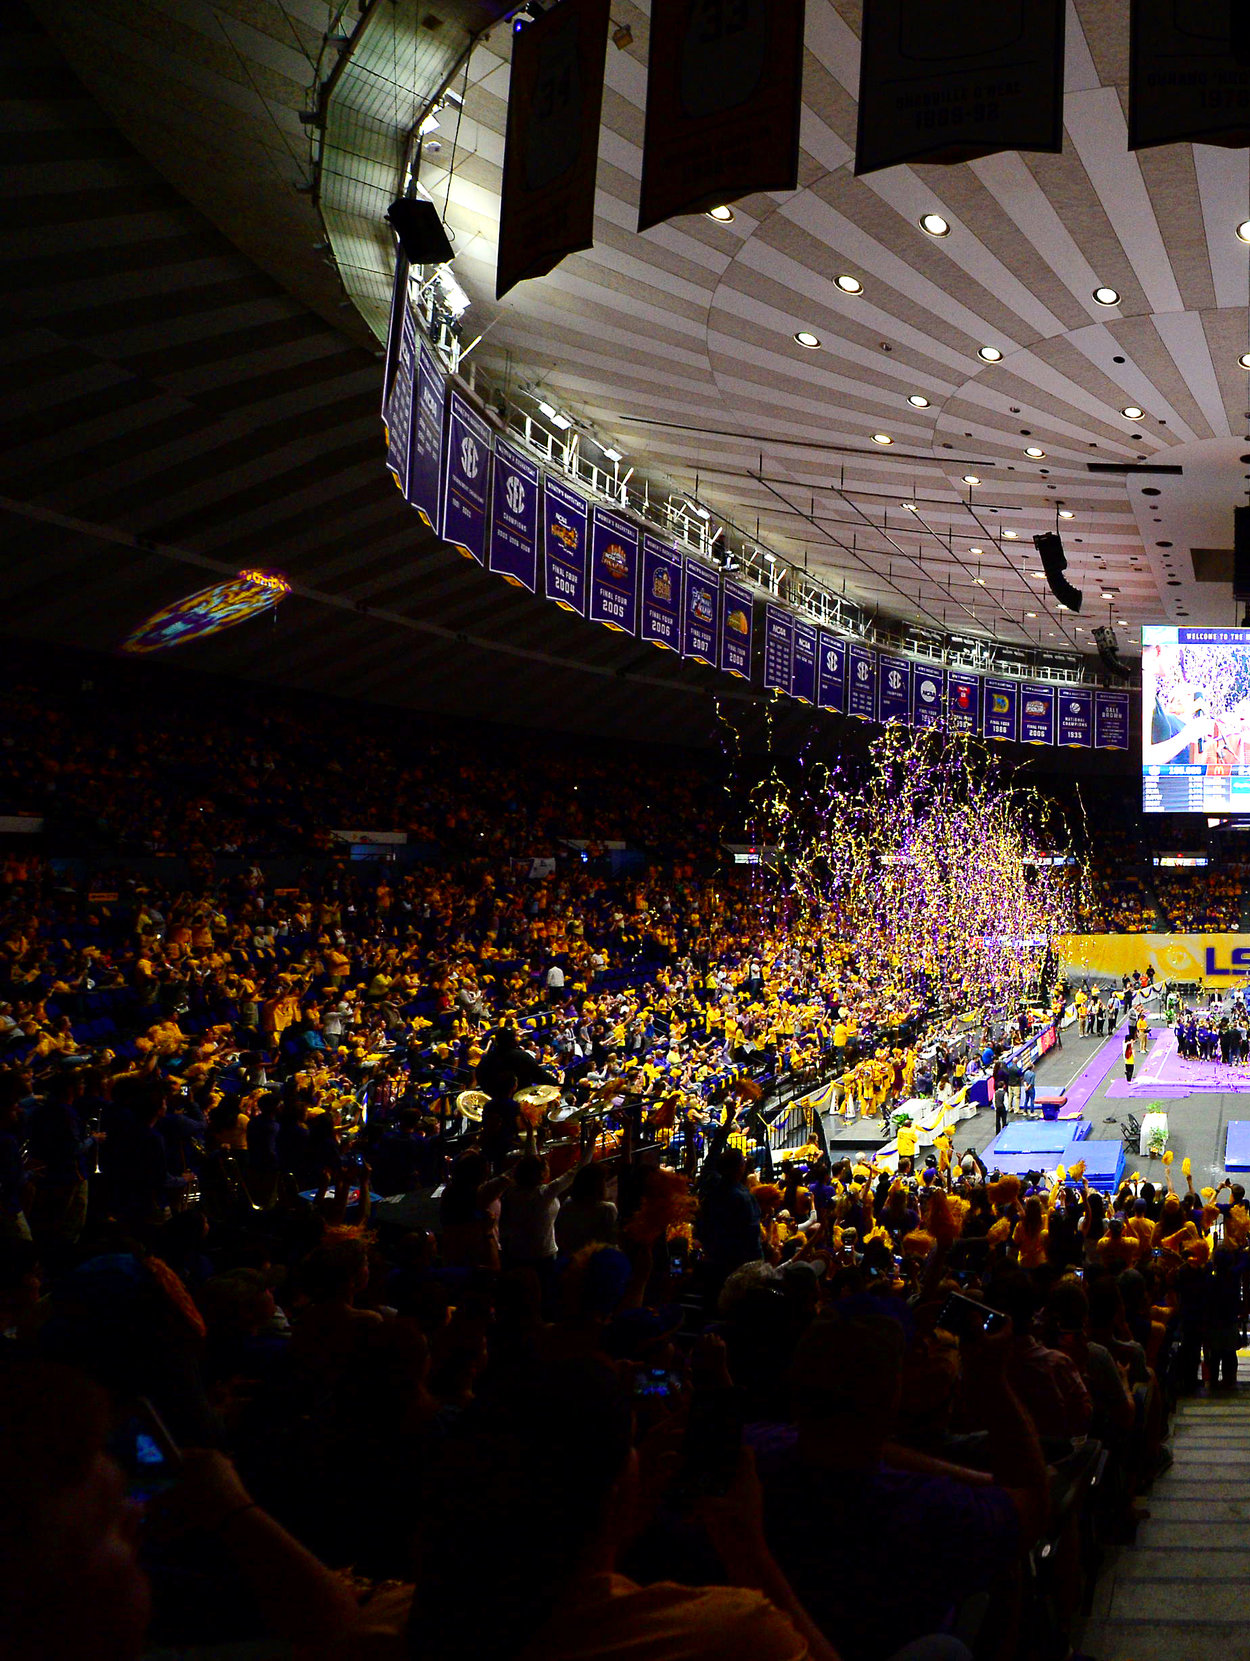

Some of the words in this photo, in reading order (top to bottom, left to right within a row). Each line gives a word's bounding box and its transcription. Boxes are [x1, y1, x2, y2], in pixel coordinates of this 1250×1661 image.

[461, 437, 479, 479] SEC
[506, 476, 525, 514] SEC
[552, 563, 565, 578] FINAL
[565, 570, 579, 584] FOUR
[555, 576, 576, 597] 2004
[600, 588, 614, 601] FINAL
[615, 593, 628, 606] FOUR
[602, 599, 624, 618] 2005
[649, 608, 661, 621] FINAL
[661, 614, 674, 626] FOUR
[651, 620, 671, 637] 2006
[690, 627, 702, 639] FINAL
[701, 632, 712, 642] FOUR
[1186, 633, 1217, 641] WELCOME
[1231, 633, 1243, 641] THE
[692, 638, 709, 653] 2007
[827, 650, 838, 672] SEC
[857, 661, 869, 681] SEC
[888, 670, 902, 689] SEC
[1067, 731, 1083, 739] 1935
